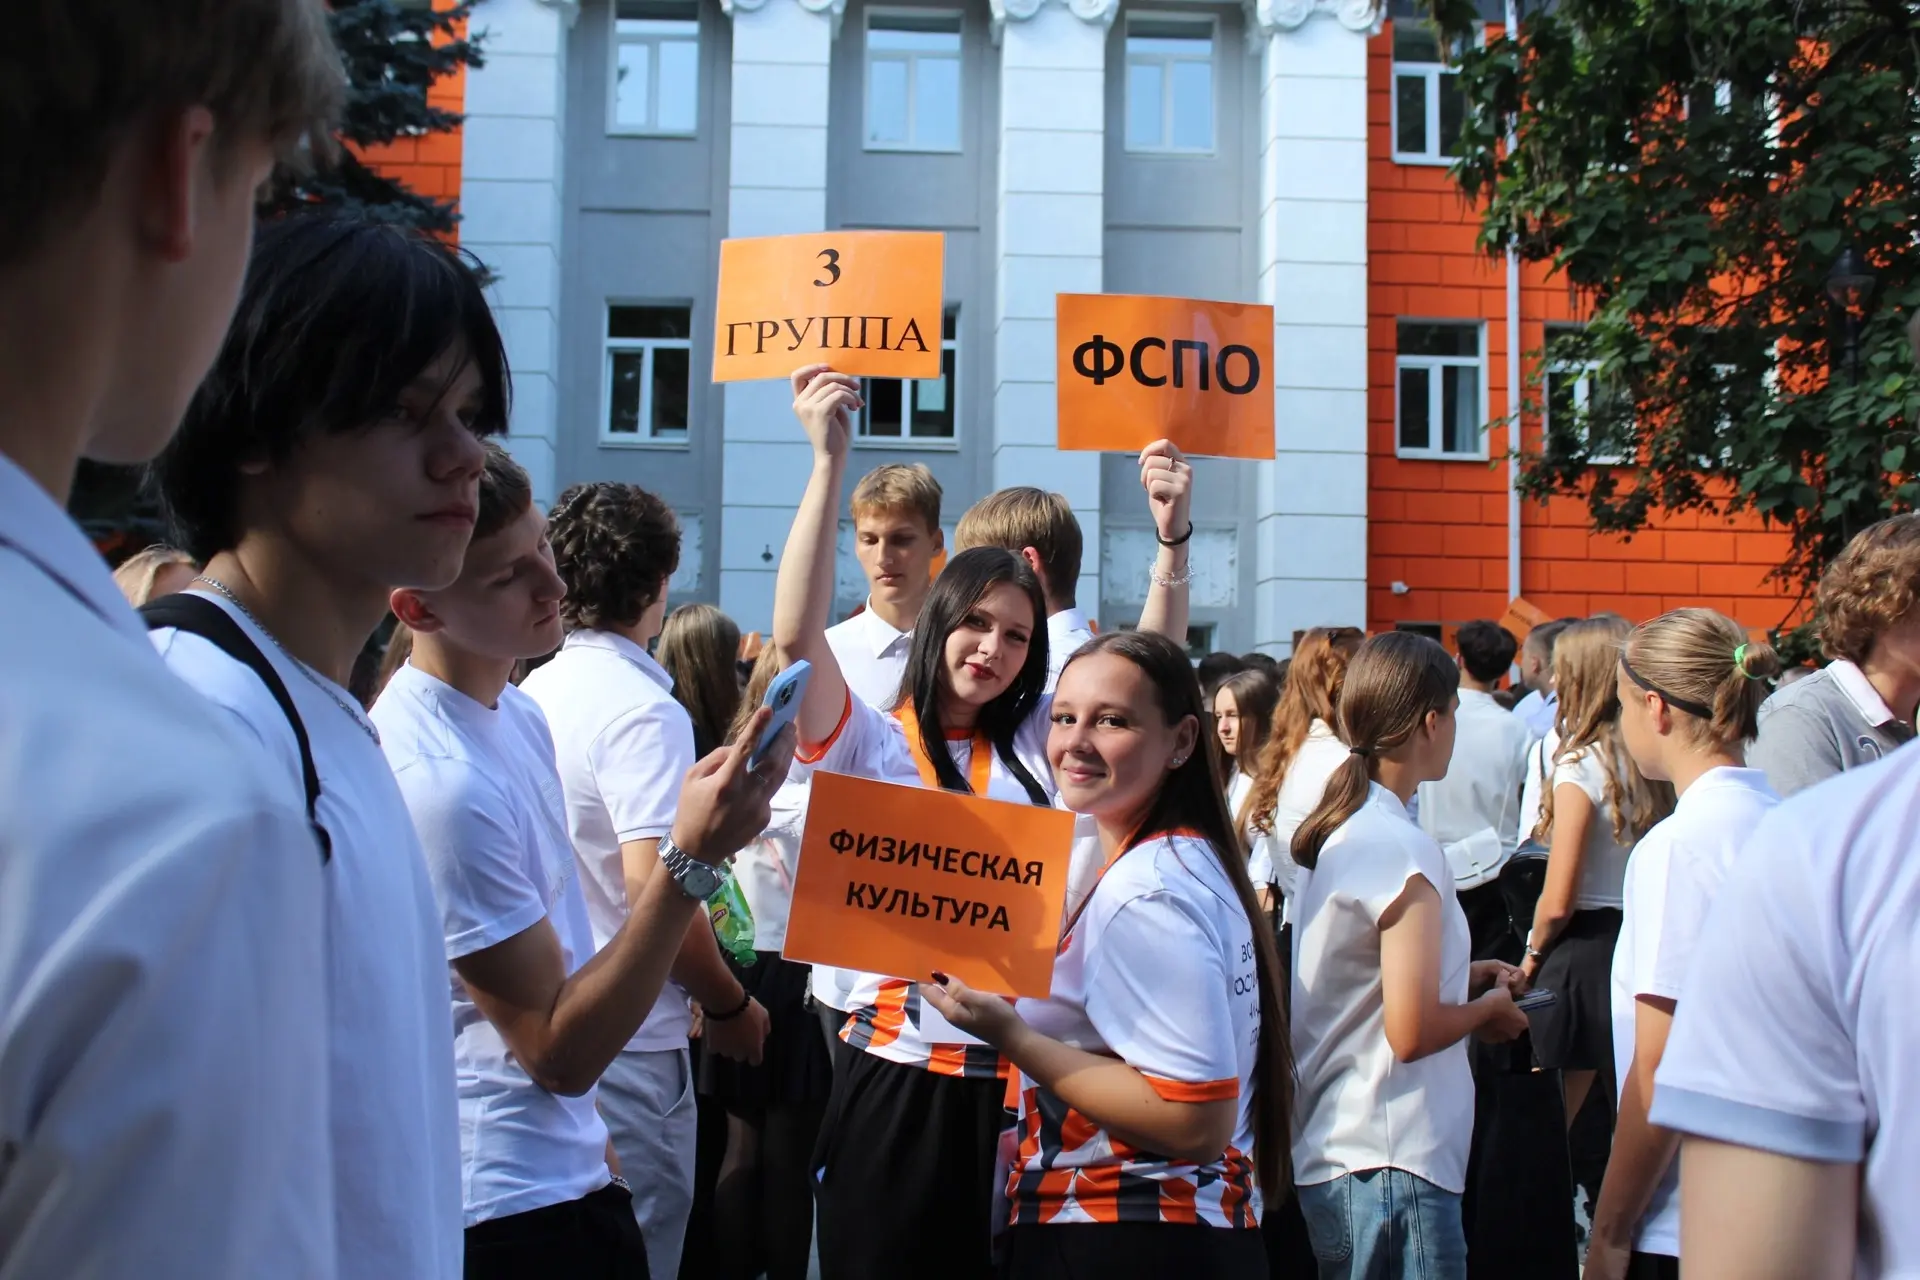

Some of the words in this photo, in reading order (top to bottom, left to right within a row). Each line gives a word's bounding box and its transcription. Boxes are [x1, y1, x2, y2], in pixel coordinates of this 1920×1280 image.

[813, 248, 841, 287] 3
[725, 316, 931, 356] ГРУППА
[1072, 334, 1261, 395] ФСПО
[829, 828, 1044, 886] ФИЗИЧЕСКАЯ
[845, 881, 1011, 932] КУЛЬТУРА
